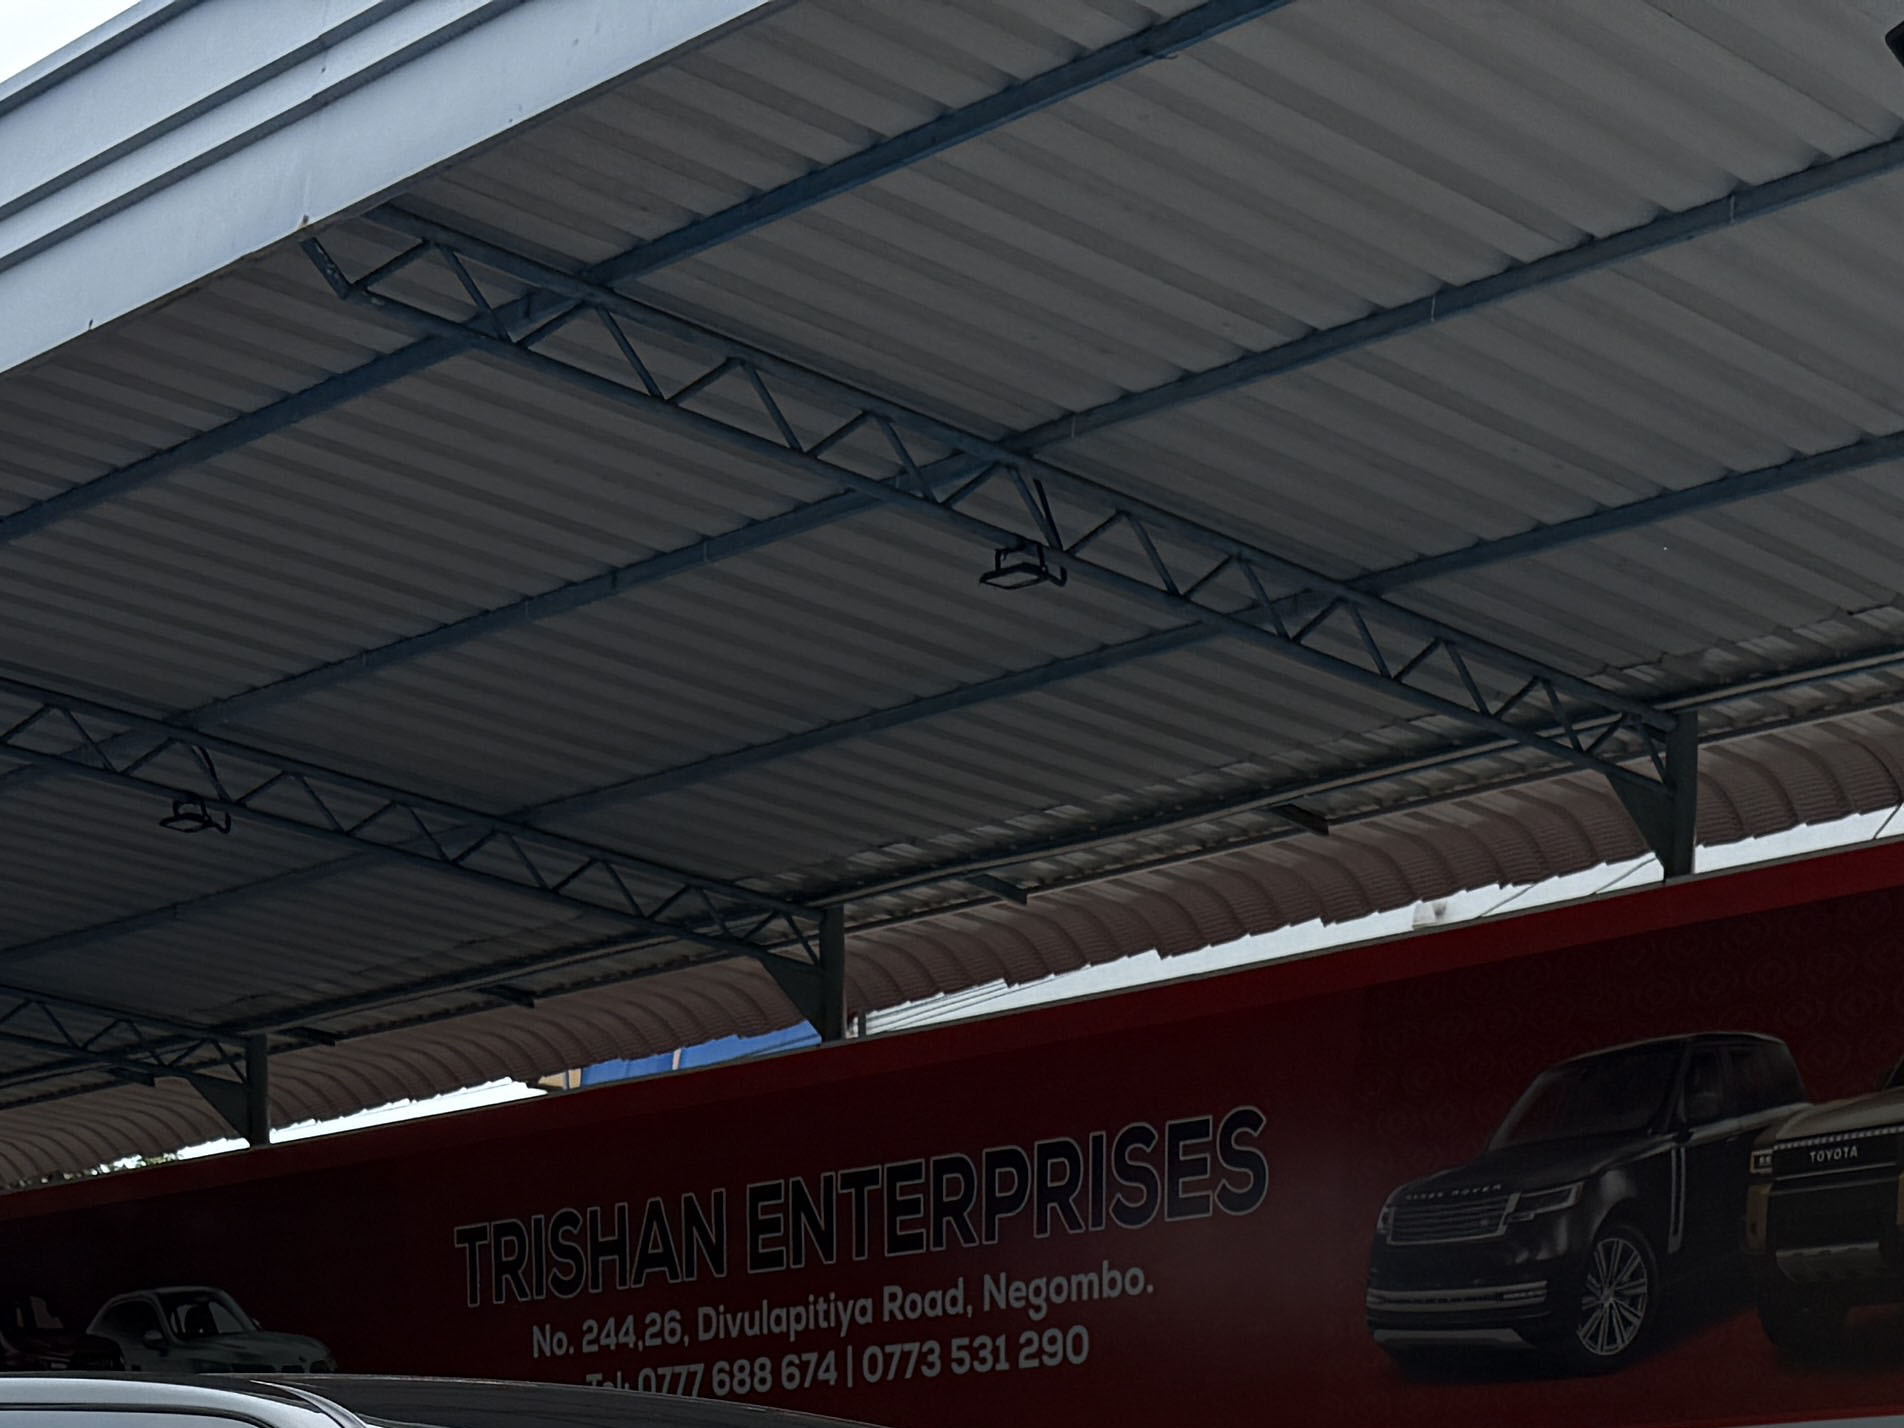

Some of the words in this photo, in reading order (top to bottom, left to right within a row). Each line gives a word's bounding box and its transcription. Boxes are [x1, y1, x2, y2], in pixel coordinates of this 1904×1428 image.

[1809, 1145, 1858, 1164] TOYOTA
[454, 1187, 727, 1307] TRISHAN
[745, 1105, 1270, 1273] ENTERPRISES
[532, 1324, 575, 1358] No.
[698, 1295, 874, 1342] Divulapitiya
[882, 1276, 974, 1320] Road,
[982, 1259, 1155, 1322] Negombo.
[712, 1347, 773, 1398] 688
[780, 1346, 838, 1394] 674
[862, 1330, 941, 1382] 0773
[950, 1332, 1010, 1376] 531
[1019, 1323, 1091, 1370] 290
